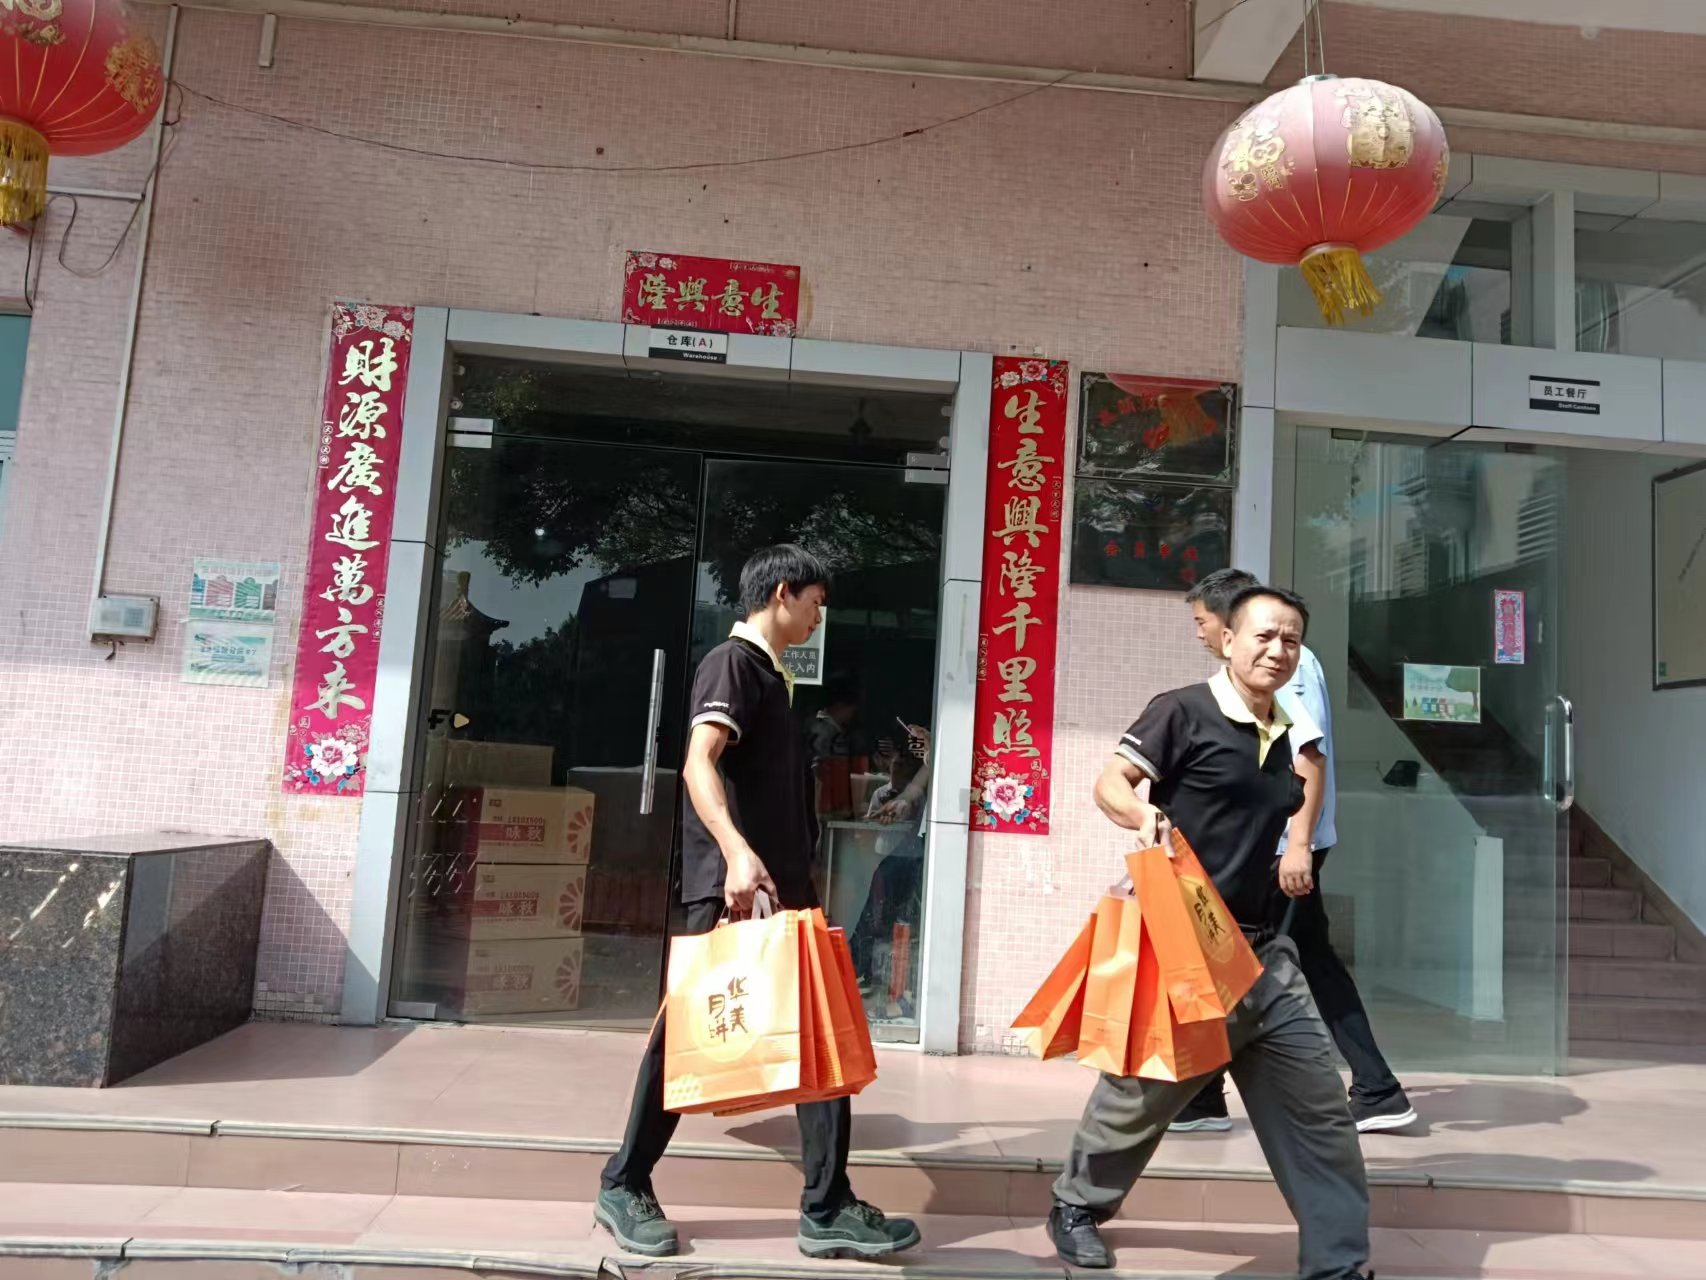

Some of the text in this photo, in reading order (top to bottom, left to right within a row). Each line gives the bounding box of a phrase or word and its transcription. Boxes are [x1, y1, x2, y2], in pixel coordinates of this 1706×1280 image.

[683, 352, 718, 361] Warehouse
[1543, 385, 1587, 399] 员工餐厅
[728, 976, 749, 1033] 华美
